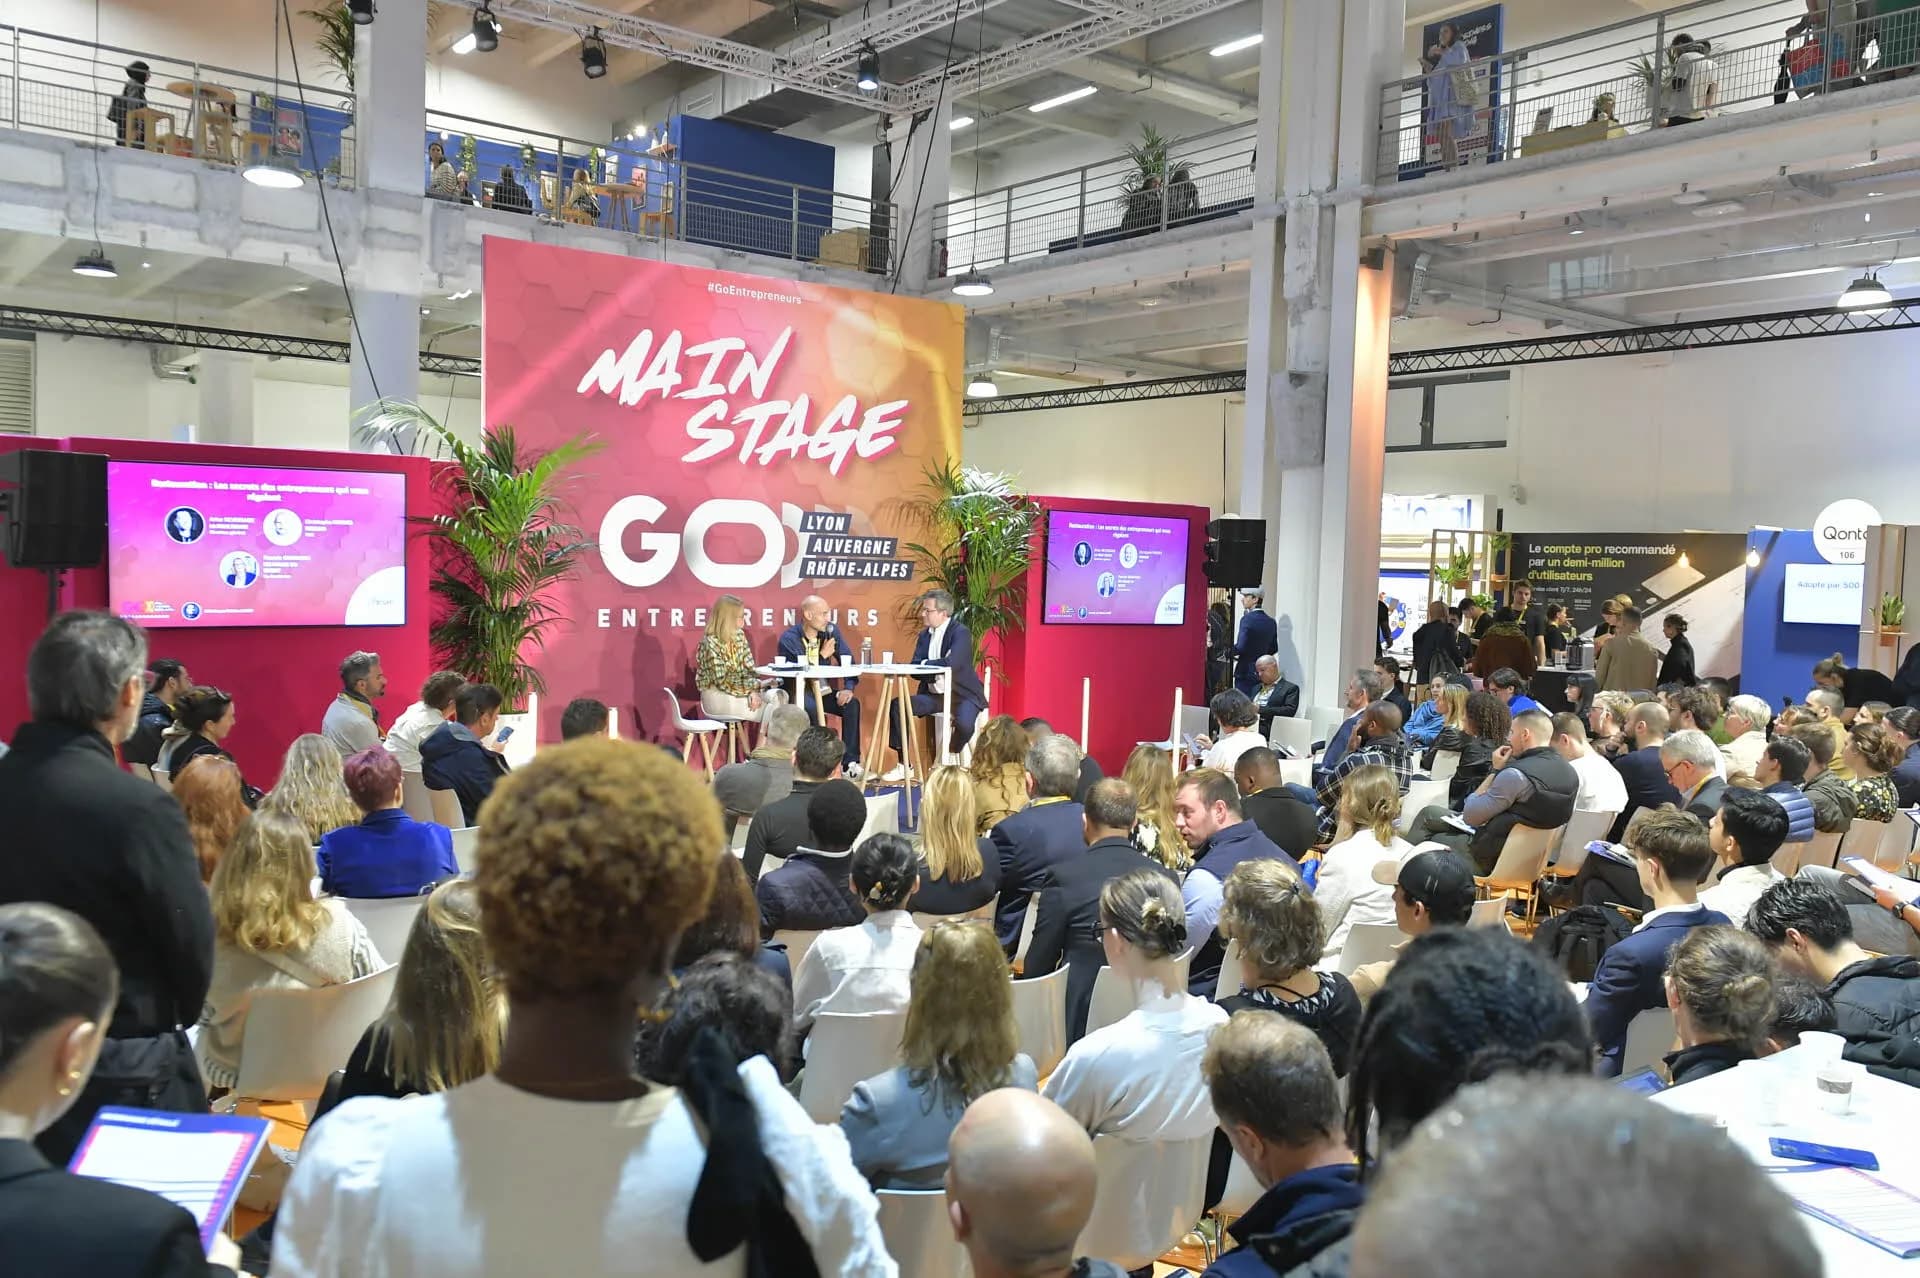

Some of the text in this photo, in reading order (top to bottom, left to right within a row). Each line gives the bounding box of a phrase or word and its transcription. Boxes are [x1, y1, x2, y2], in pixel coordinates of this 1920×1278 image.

[707, 281, 802, 305] #GoEntrepreneurs
[577, 326, 792, 406] MAIN
[681, 393, 909, 476] STAGE
[807, 515, 845, 531] LYON
[813, 538, 891, 555] AUVERGNE
[1529, 544, 1676, 555] Le compte pro recommandé
[806, 558, 908, 578] RHÔNE-ALPES
[1528, 557, 1625, 568] par un demi-million
[1528, 570, 1593, 581] d'utilisateurs
[597, 608, 879, 627] ENTRERENURS
